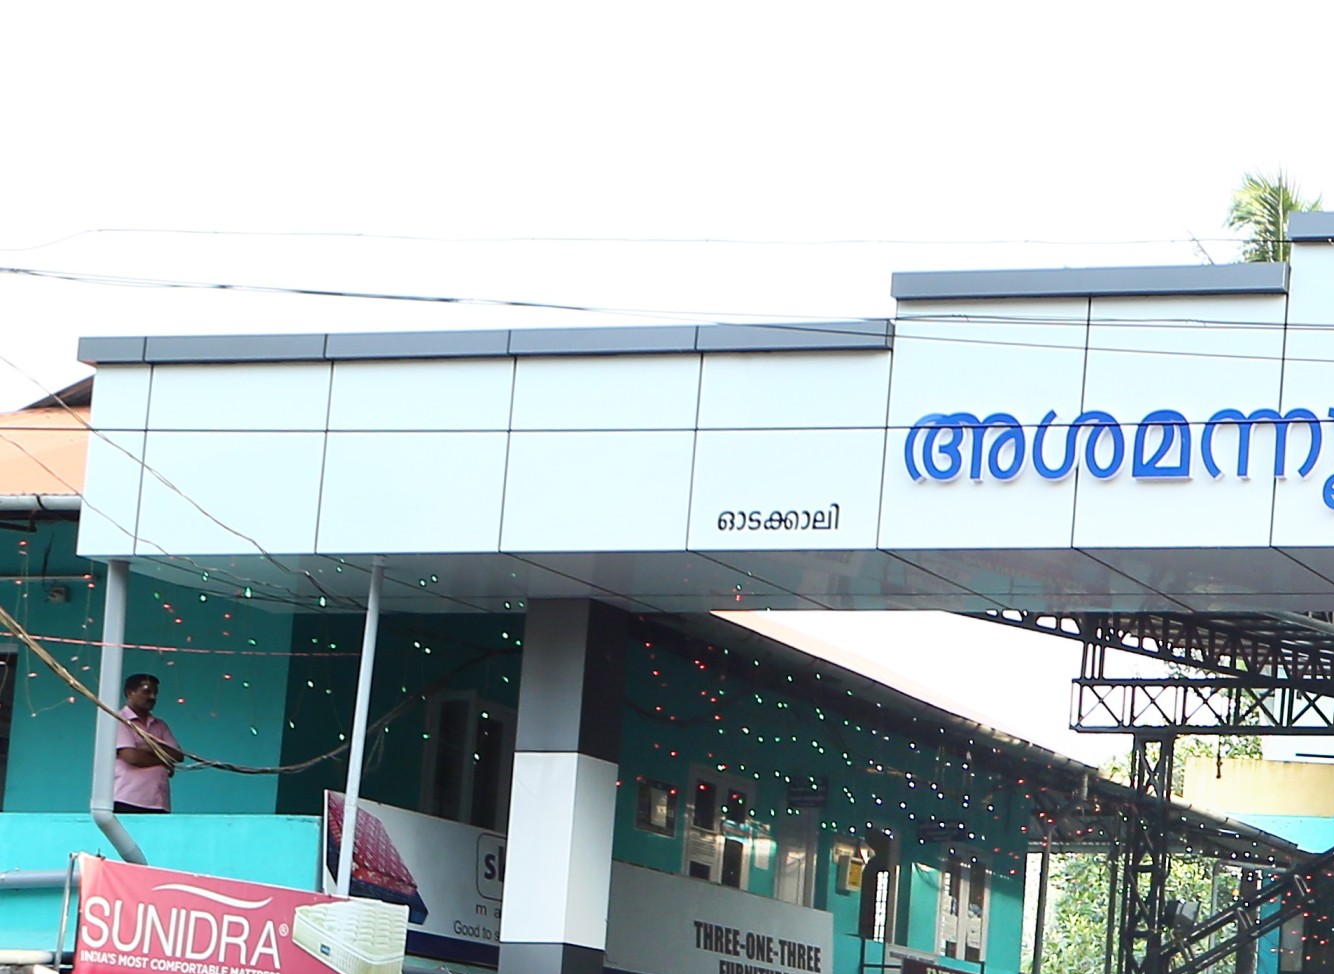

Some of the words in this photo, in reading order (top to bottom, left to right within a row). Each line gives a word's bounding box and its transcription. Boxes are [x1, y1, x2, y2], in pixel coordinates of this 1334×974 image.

[717, 502, 840, 531] ഓടക്കാലി
[80, 895, 281, 970] SUNIDRA
[453, 919, 481, 938] Good
[482, 926, 492, 942] to
[80, 950, 117, 965] INDIA'S
[118, 955, 149, 969] MOST
[693, 920, 822, 973] THREE-ONE-THREE
